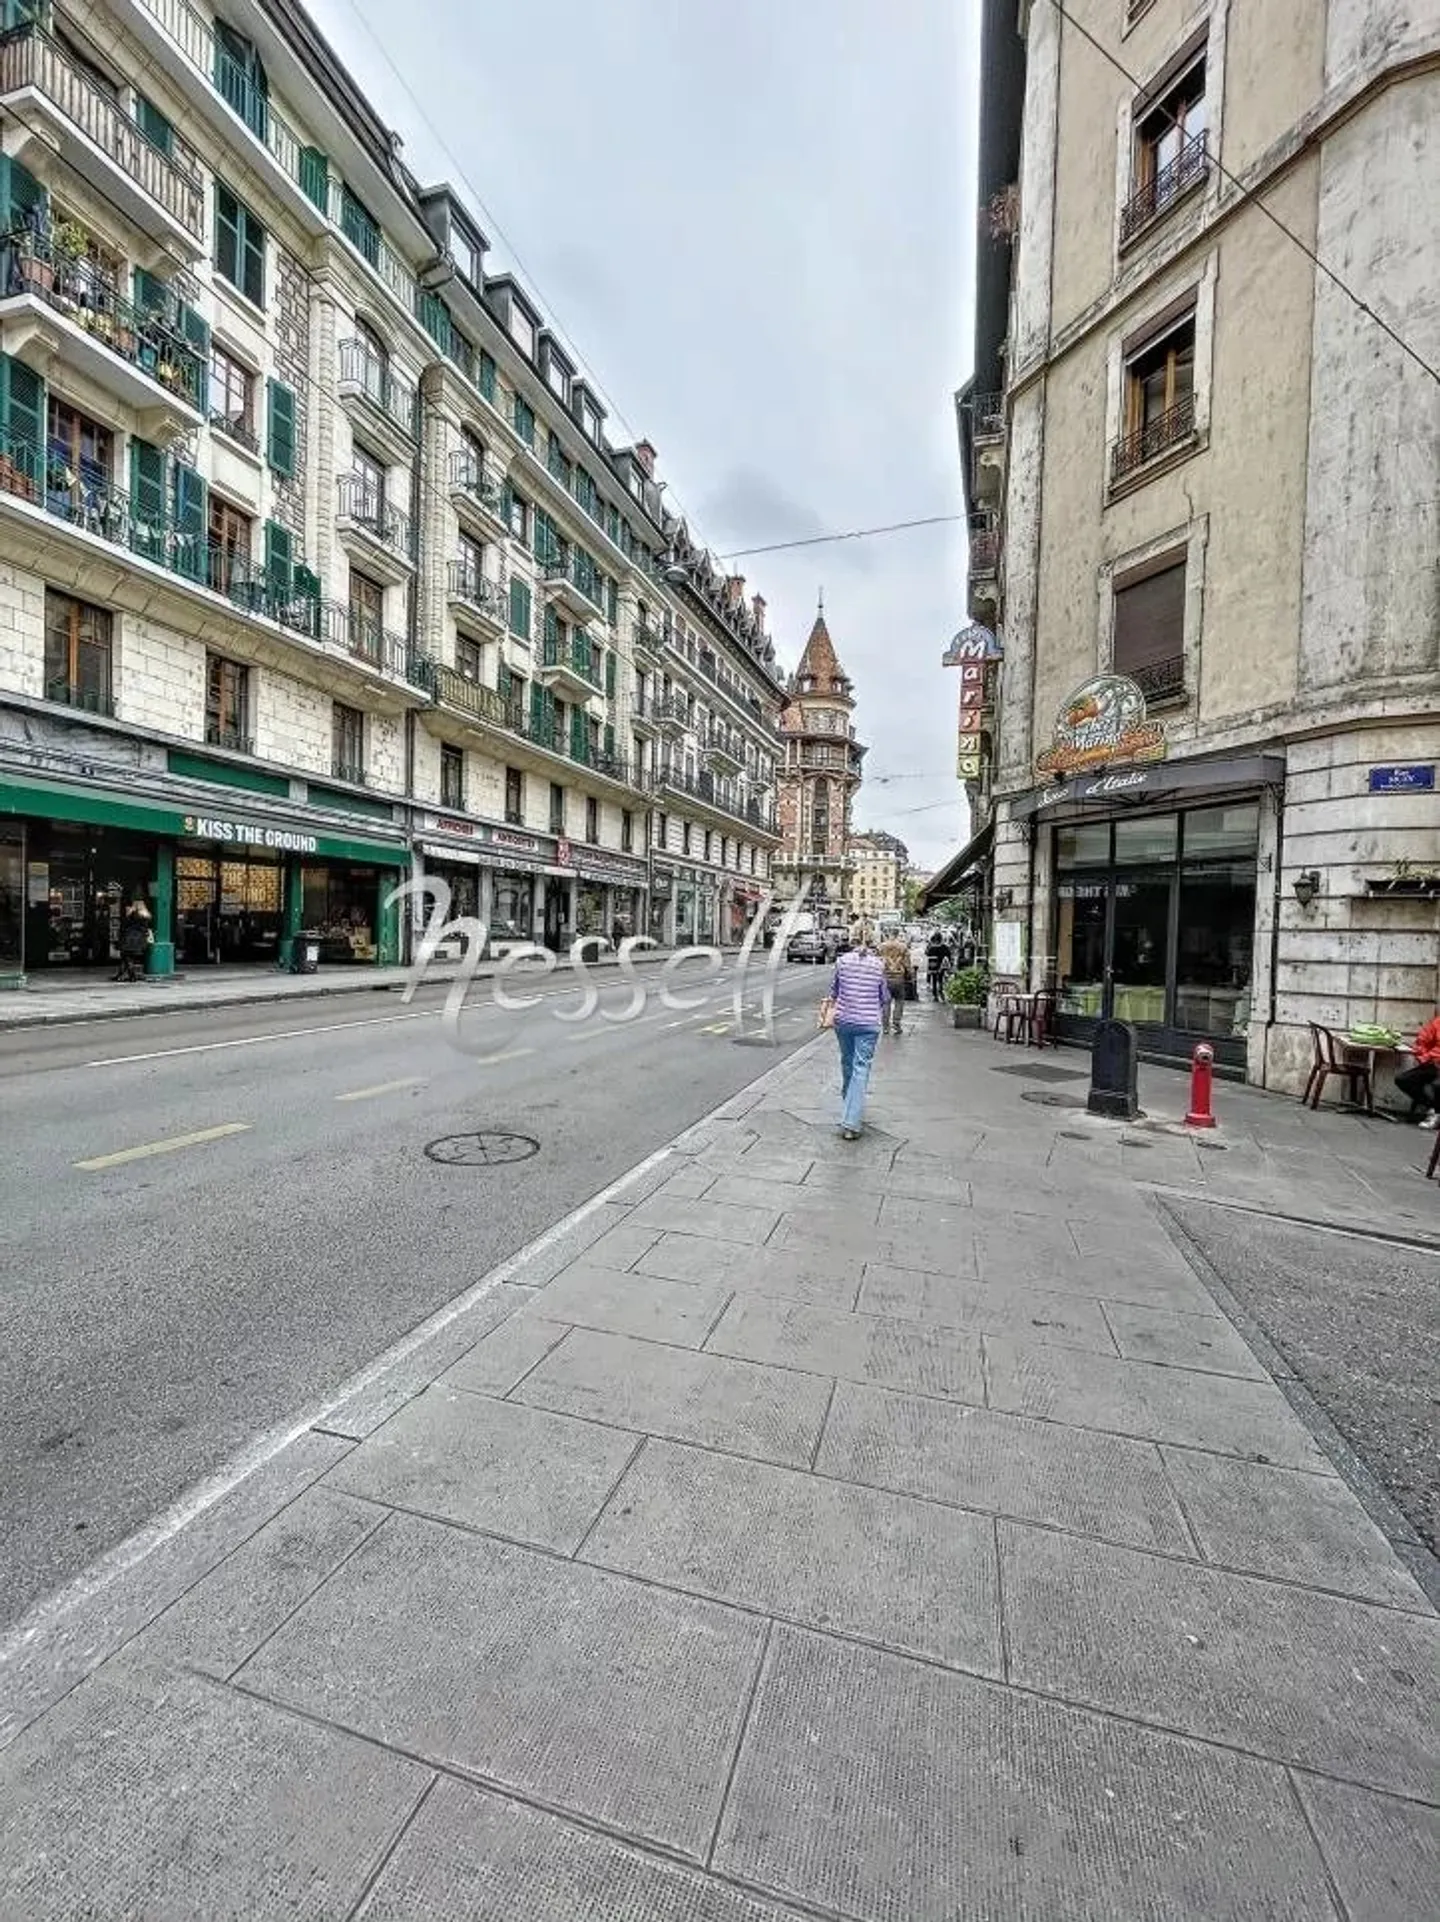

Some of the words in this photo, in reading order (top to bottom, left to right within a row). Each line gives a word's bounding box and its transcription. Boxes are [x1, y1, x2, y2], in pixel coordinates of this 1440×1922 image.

[197, 818, 233, 840] KISS
[235, 824, 264, 845] THE
[265, 830, 317, 852] GROUND
